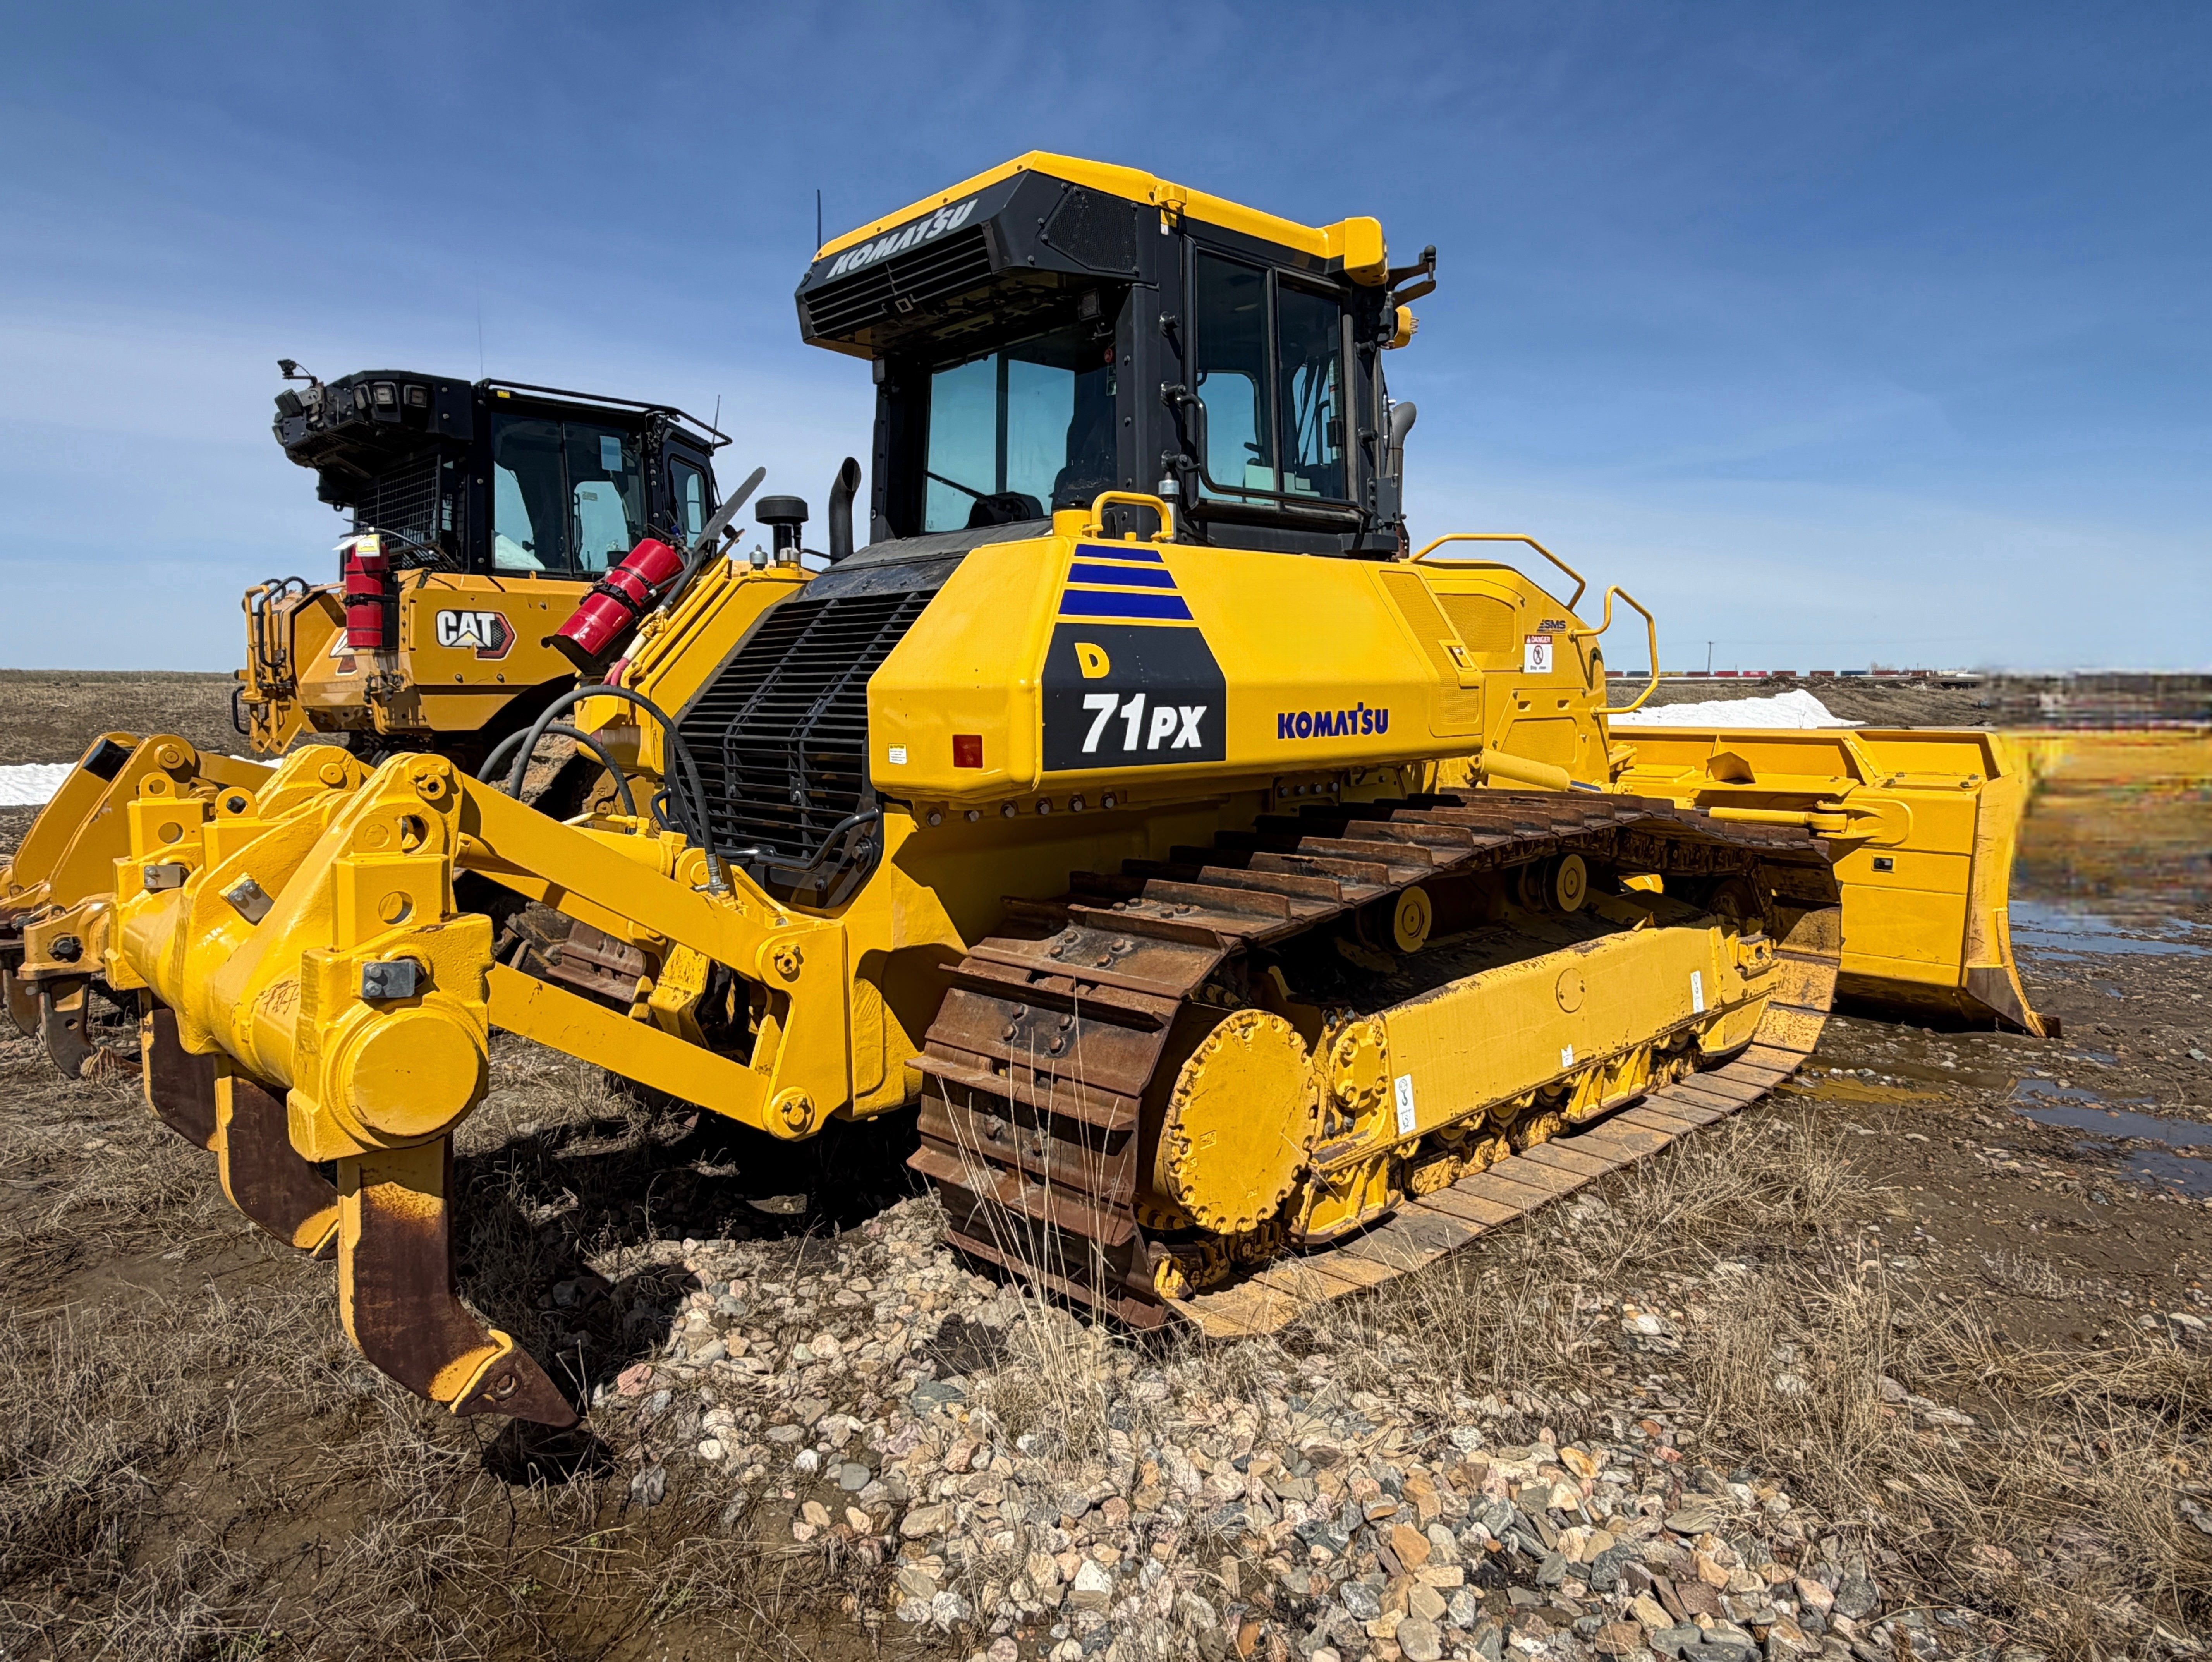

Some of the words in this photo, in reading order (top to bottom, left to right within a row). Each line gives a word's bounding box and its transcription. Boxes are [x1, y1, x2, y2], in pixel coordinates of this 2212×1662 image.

[826, 198, 979, 279] KOMATSU
[437, 611, 495, 647] CAT
[1544, 620, 1566, 629] SMS
[1075, 642, 1110, 679] D
[1277, 702, 1389, 739] KOMATSU
